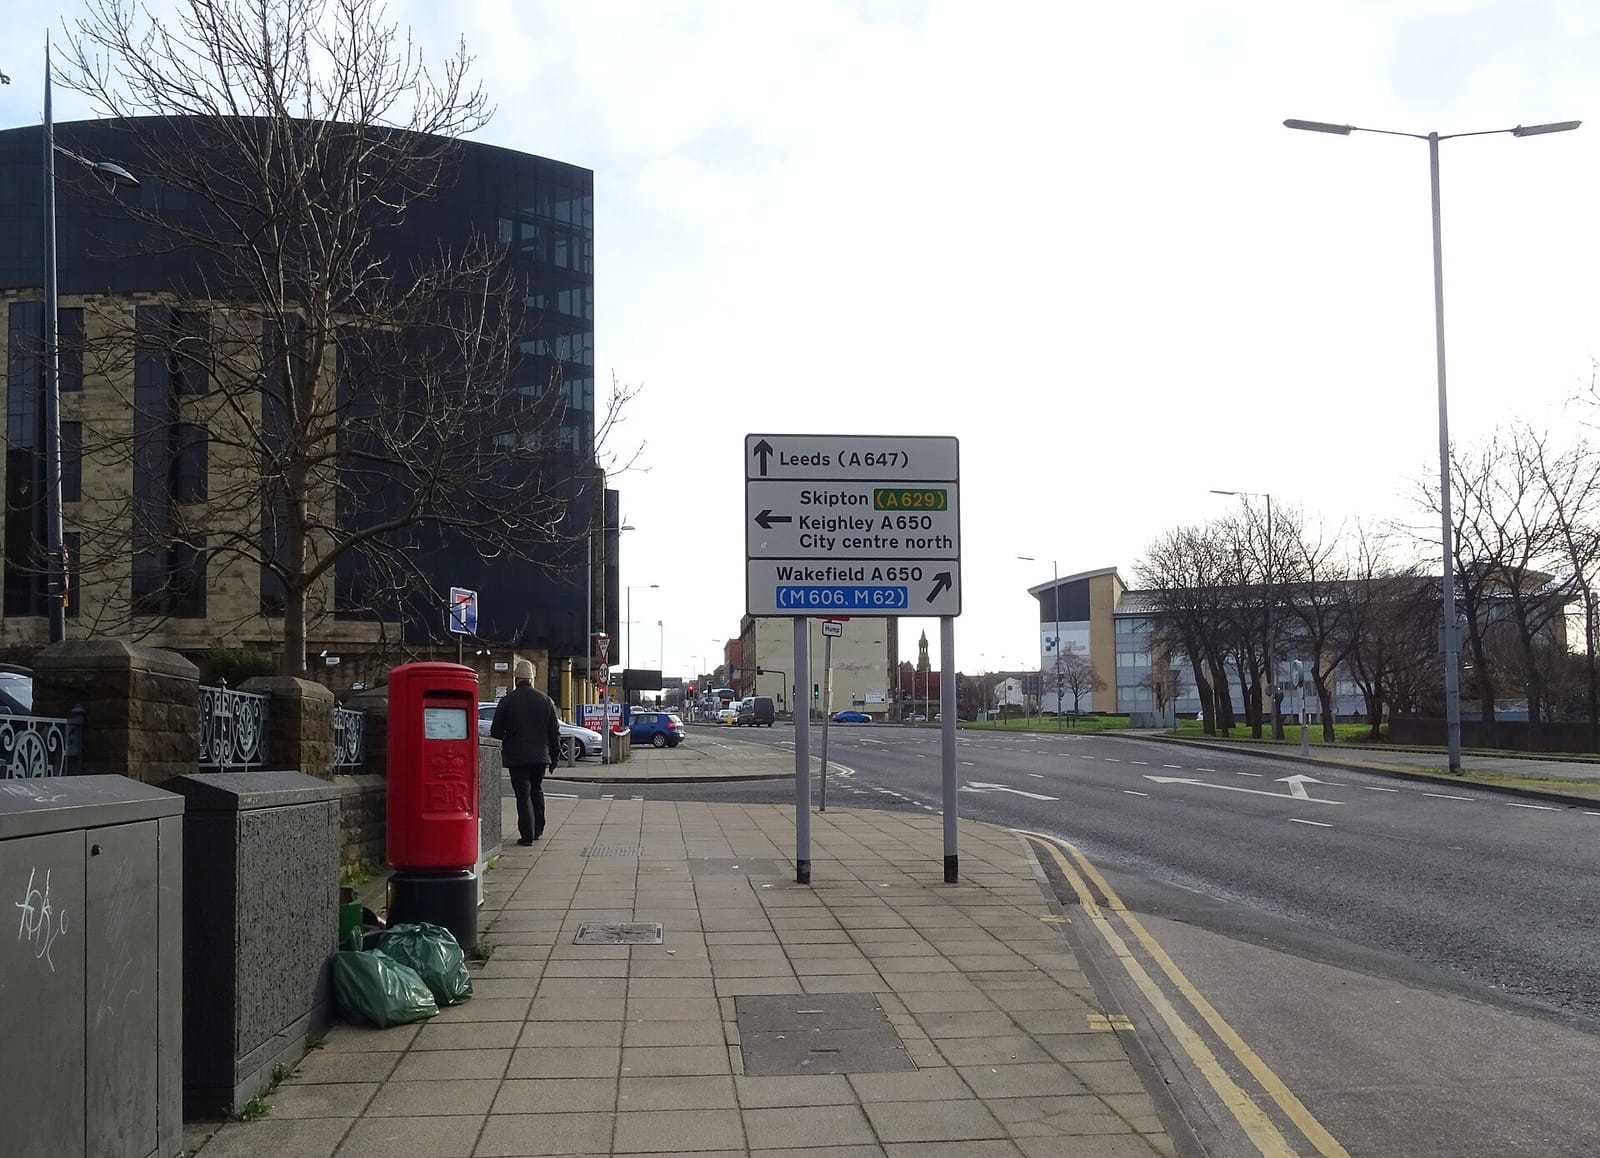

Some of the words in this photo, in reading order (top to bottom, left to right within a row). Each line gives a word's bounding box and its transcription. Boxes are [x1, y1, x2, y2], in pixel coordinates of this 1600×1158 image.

[780, 451, 830, 466] Leeds
[800, 490, 869, 508] Skipton
[799, 515, 874, 533] Keighley
[881, 515, 932, 530] A650
[800, 533, 836, 551] City
[842, 535, 899, 549] centre
[905, 534, 953, 549] north
[776, 566, 864, 581] Wakefield
[871, 566, 923, 582] A650
[824, 625, 840, 633] Hump
[600, 667, 608, 678] 30
